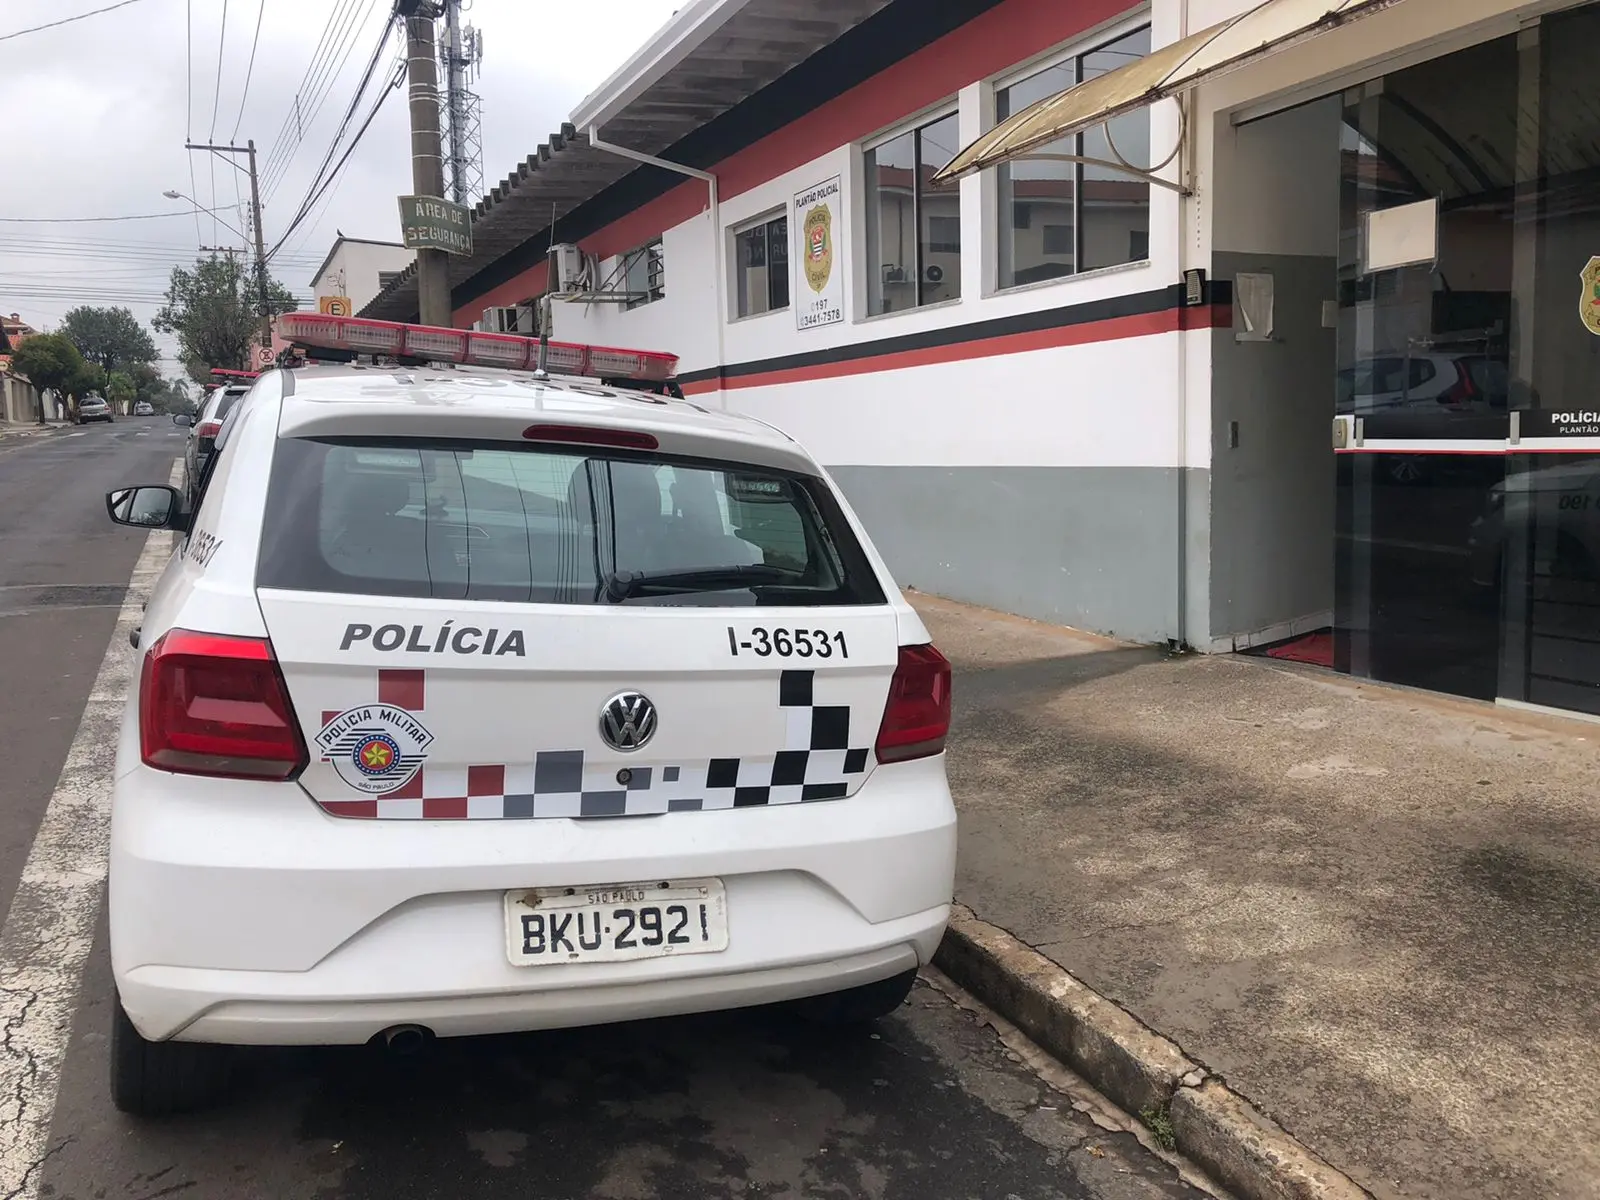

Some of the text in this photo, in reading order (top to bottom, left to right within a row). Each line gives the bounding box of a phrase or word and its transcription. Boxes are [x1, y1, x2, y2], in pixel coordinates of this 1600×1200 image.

[796, 183, 839, 208] PLANTÃO POLICIAL
[416, 200, 463, 224] ÁREA DE
[407, 226, 471, 251] SEGURANÇA
[331, 303, 341, 316] E
[815, 299, 828, 311] 197
[804, 309, 840, 326] 3441-7578
[1551, 410, 1600, 424] POLÍCI
[1559, 425, 1599, 434] PLANTÃO
[339, 620, 526, 657] POLÍCIA
[727, 626, 849, 659] I-36531
[379, 709, 427, 744] MILITAR
